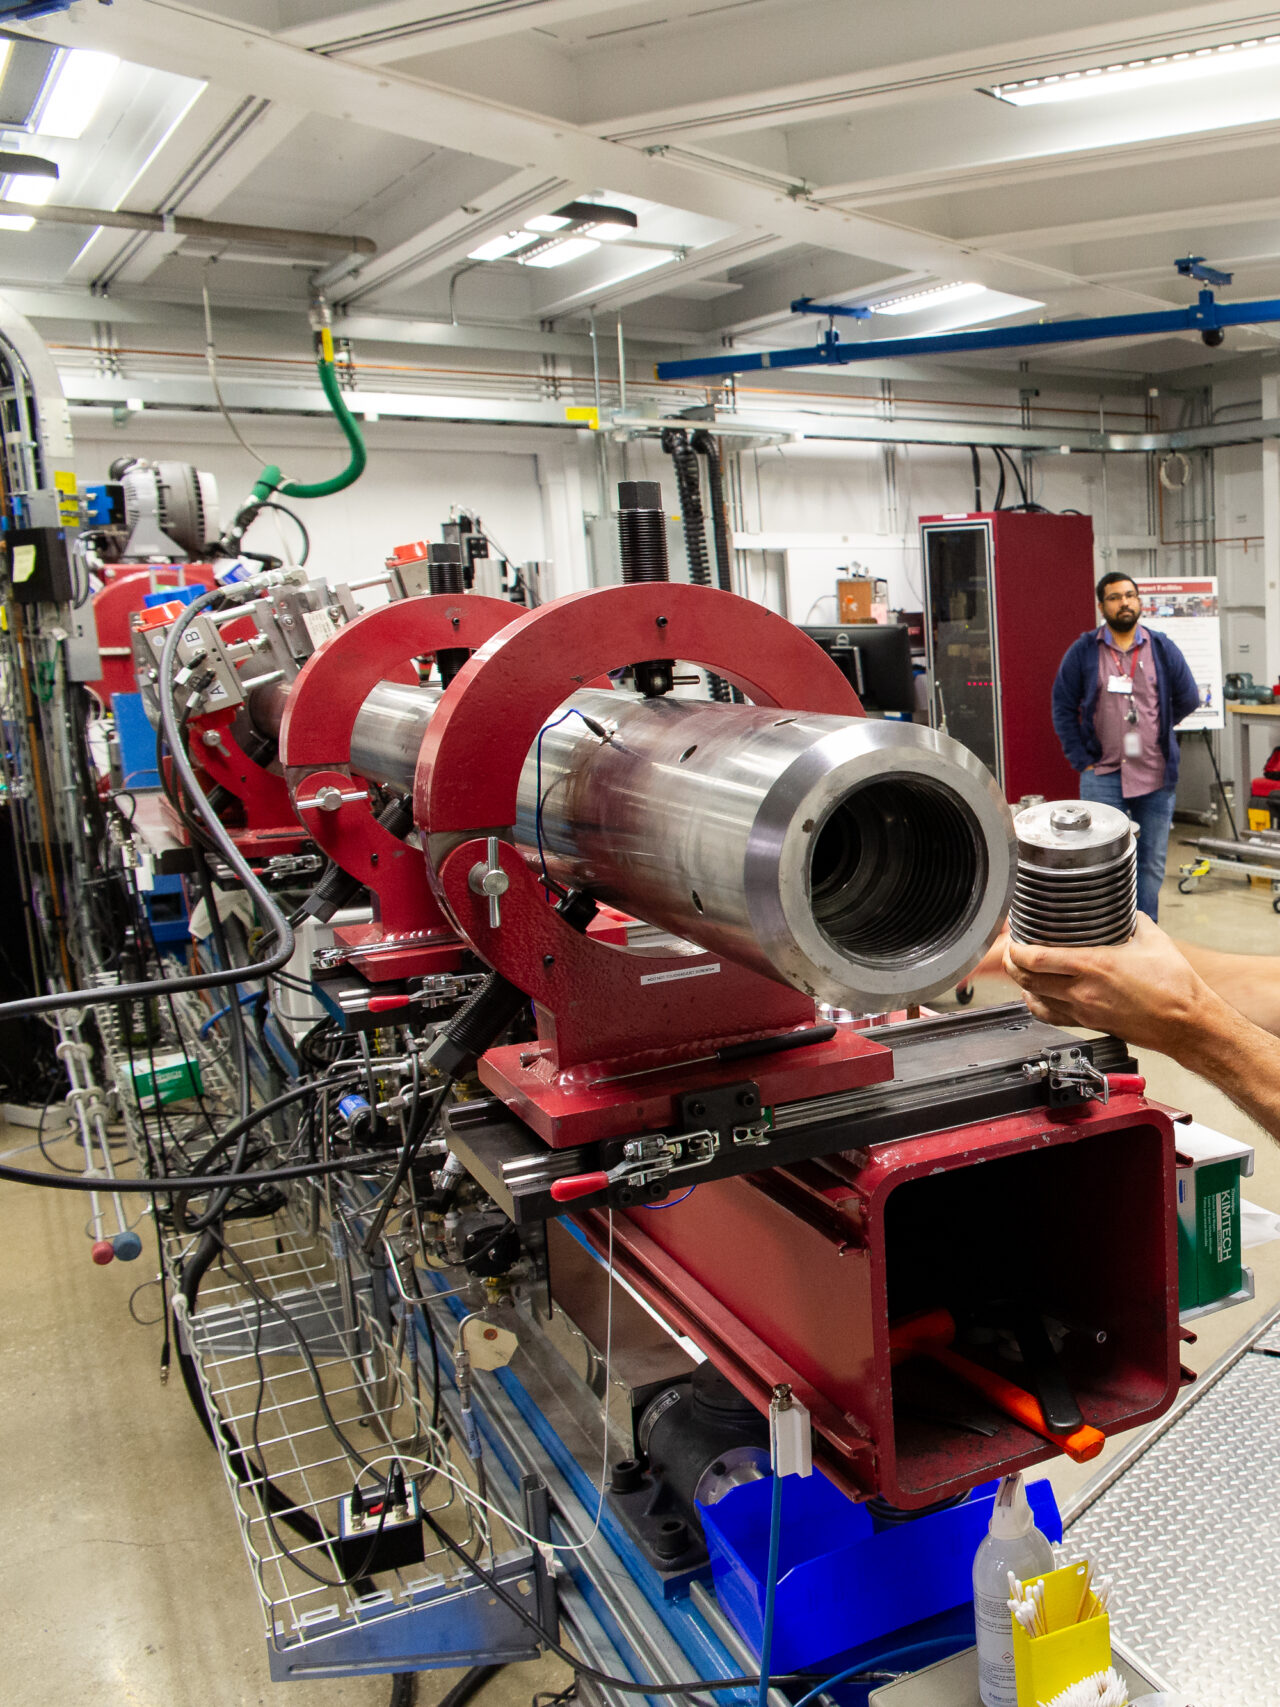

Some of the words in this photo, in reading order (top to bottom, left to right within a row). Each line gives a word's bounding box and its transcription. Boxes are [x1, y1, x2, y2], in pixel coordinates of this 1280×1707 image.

[185, 631, 200, 643] B
[210, 685, 225, 695] A
[1222, 1189, 1232, 1261] KIMTECH
